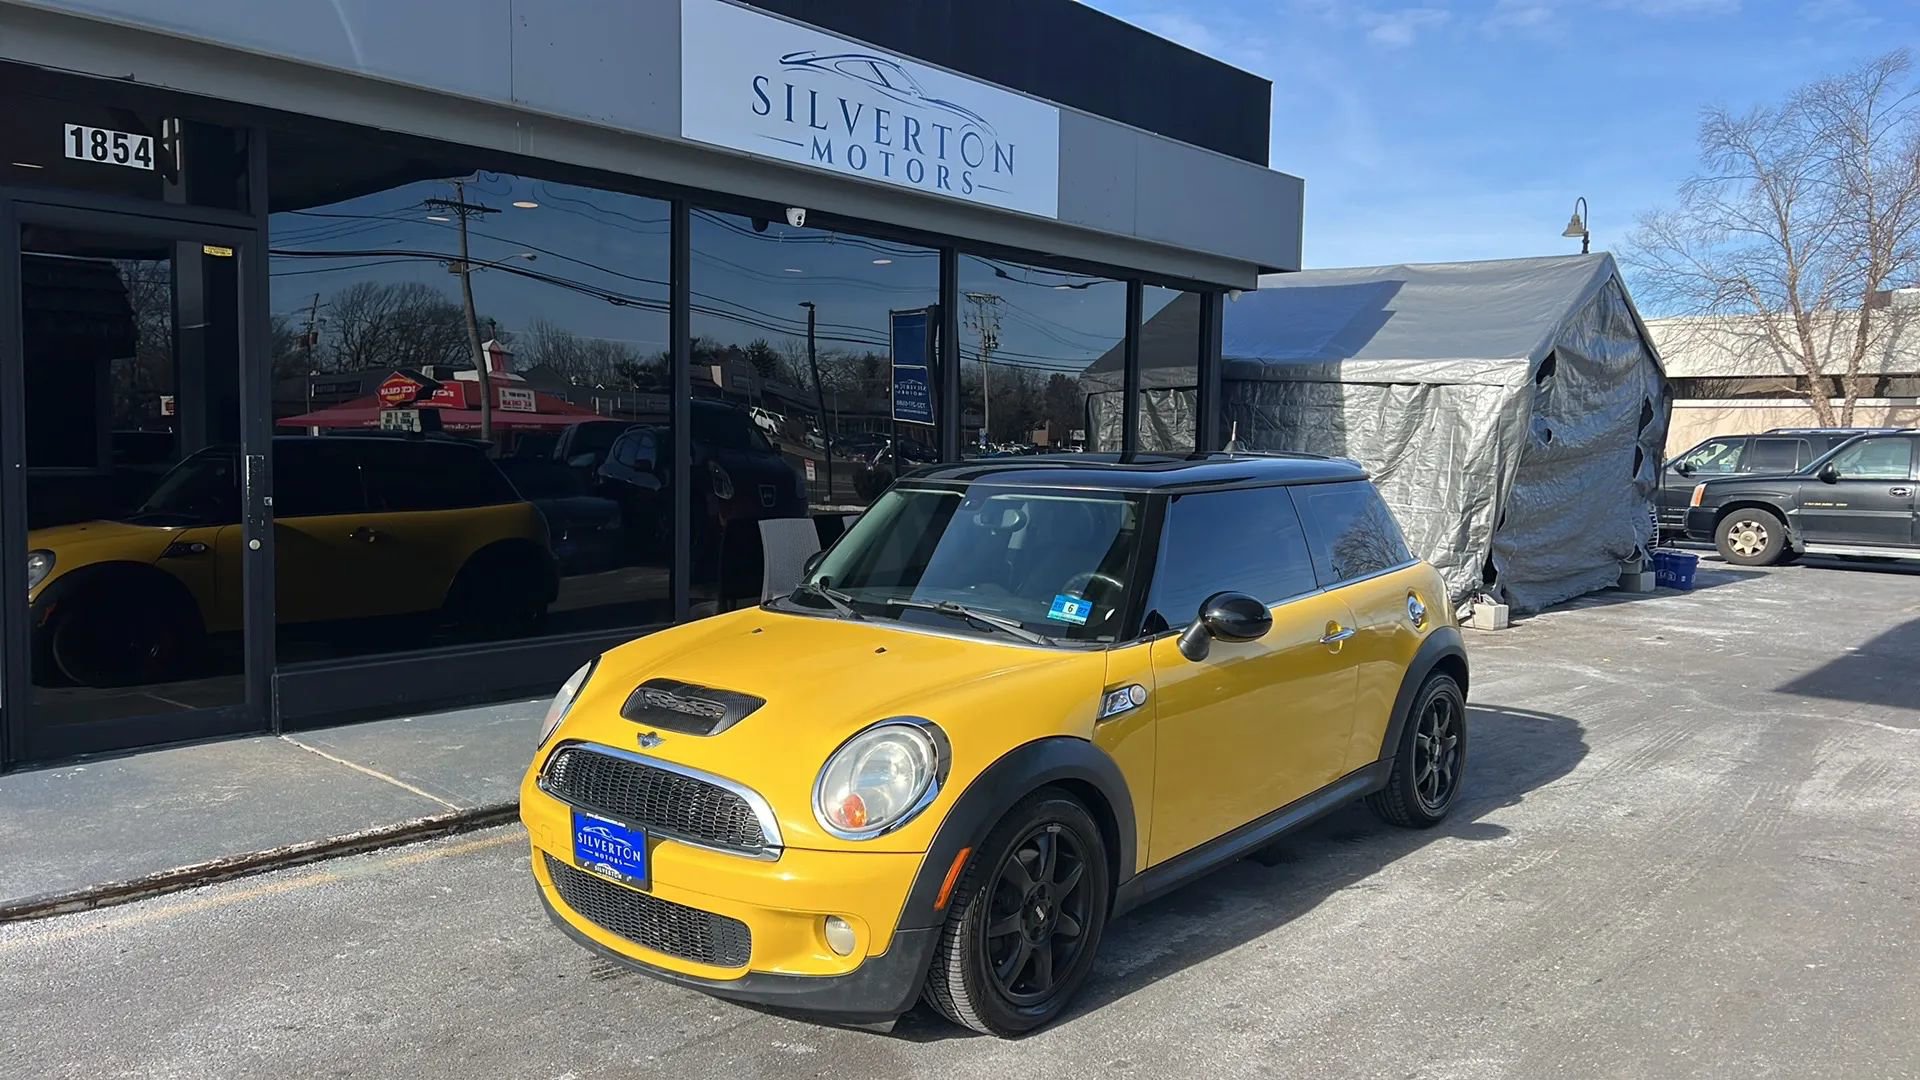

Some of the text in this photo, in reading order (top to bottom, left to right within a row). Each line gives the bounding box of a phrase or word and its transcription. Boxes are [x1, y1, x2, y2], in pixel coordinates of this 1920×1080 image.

[752, 75, 1015, 176] SILVERTON
[70, 126, 152, 168] 1854
[811, 135, 973, 195] MOTORS
[1067, 604, 1075, 613] 6
[577, 832, 641, 862] SILVERTON
[594, 851, 623, 865] MOTORS
